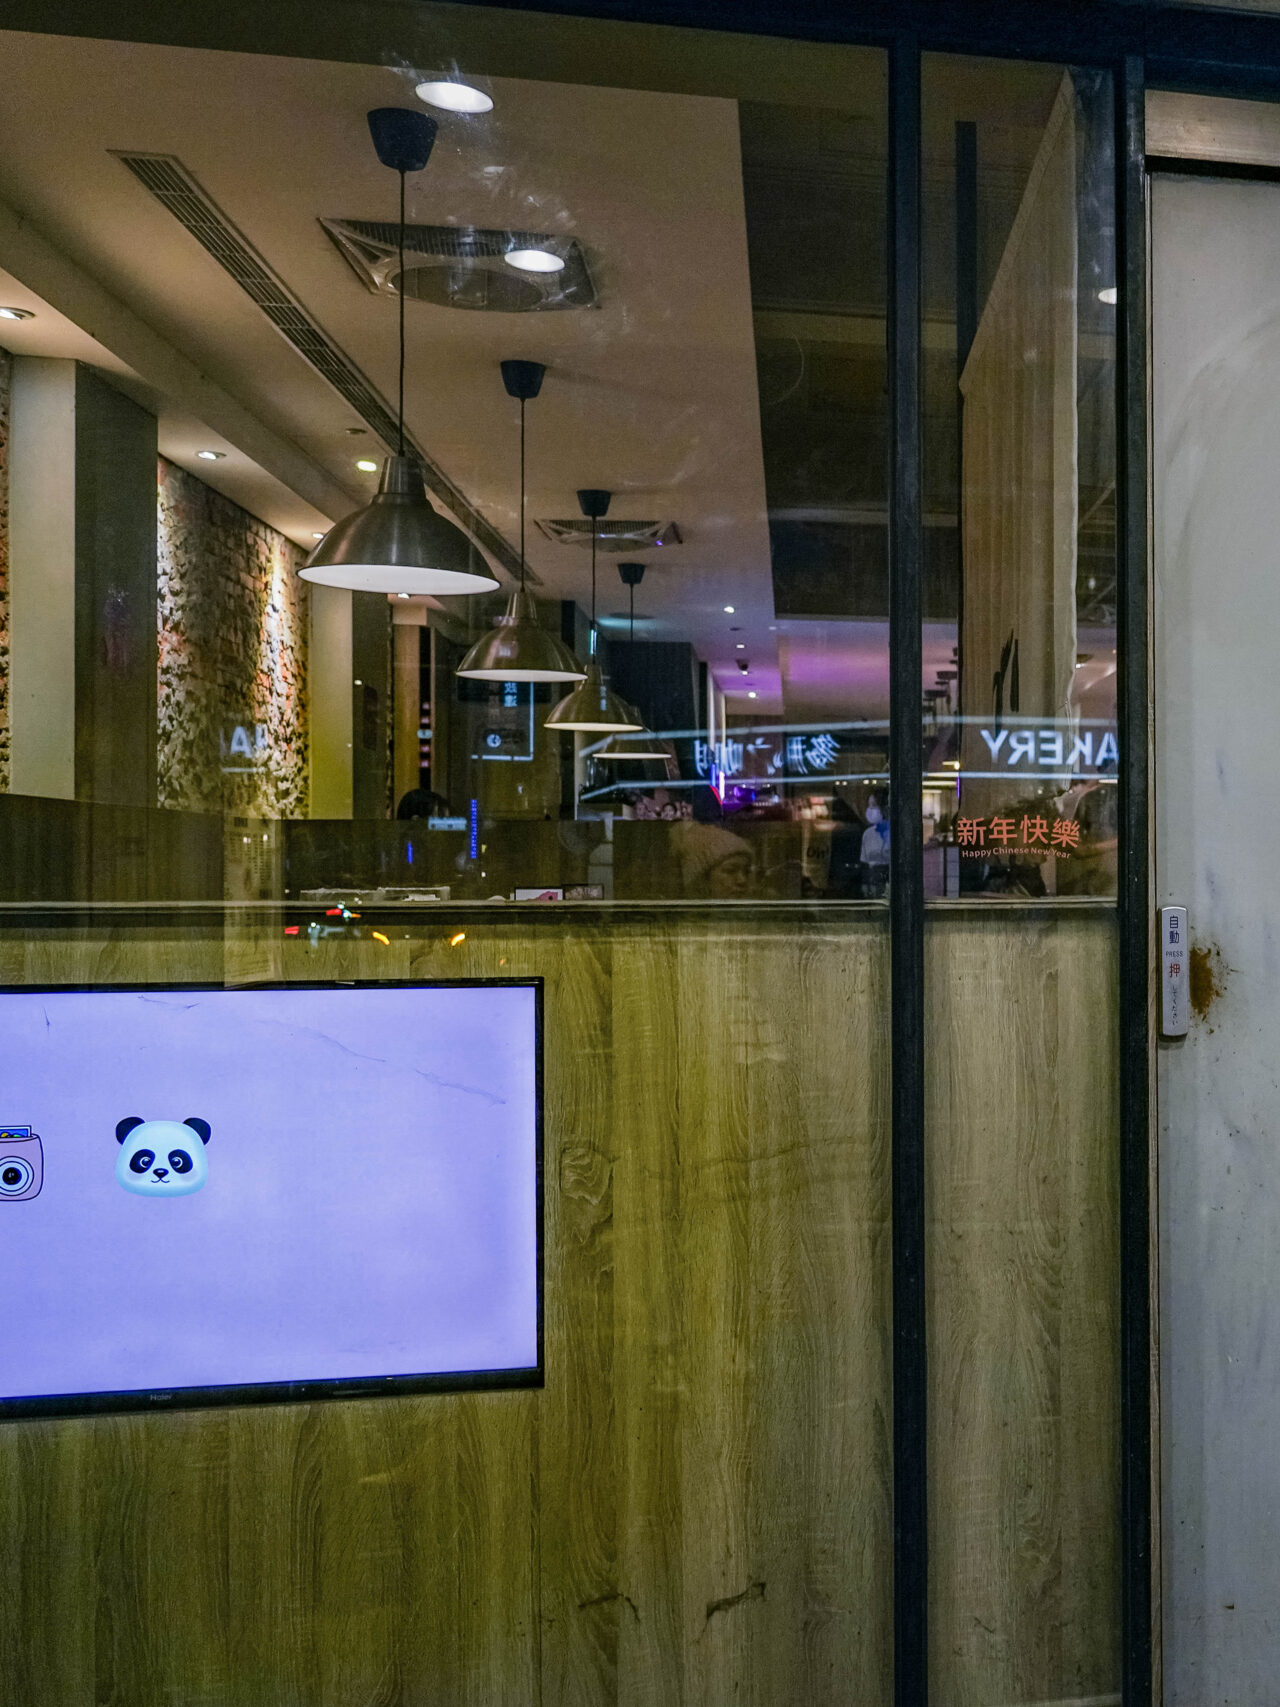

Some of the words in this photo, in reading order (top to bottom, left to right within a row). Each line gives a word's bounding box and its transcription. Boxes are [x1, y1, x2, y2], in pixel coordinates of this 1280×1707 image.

[957, 815, 1080, 848] 新年快樂
[962, 849, 992, 858] Happy
[992, 847, 1029, 855] Chinese
[1030, 847, 1050, 855] New
[1050, 848, 1071, 859] Year
[1169, 915, 1180, 944] 自動
[1165, 950, 1183, 958] PRESS
